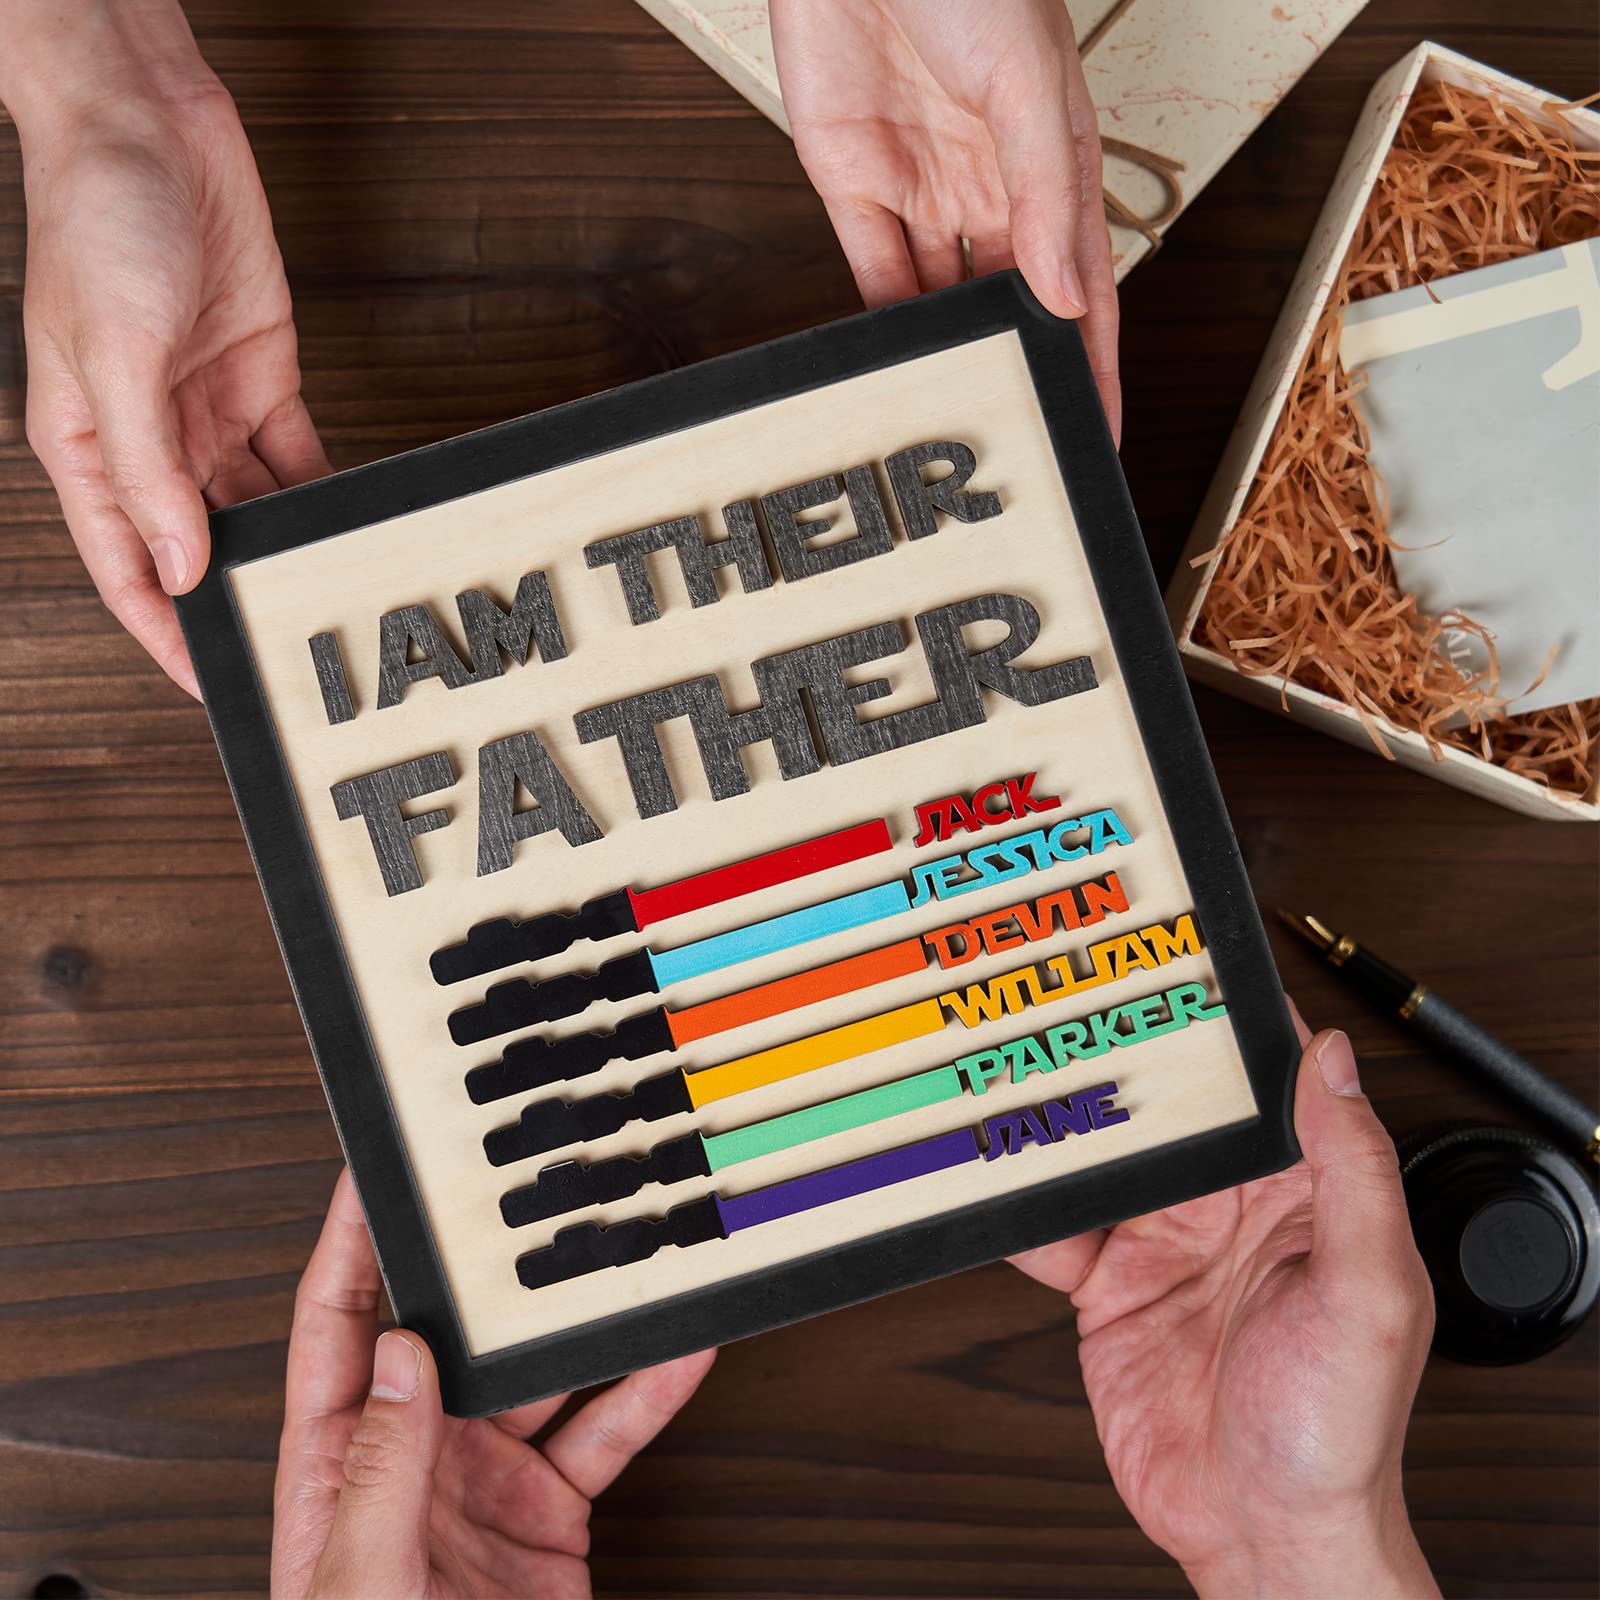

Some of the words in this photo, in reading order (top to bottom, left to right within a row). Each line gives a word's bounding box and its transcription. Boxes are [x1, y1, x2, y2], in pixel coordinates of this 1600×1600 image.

[308, 631, 357, 726] I
[377, 570, 569, 711] AM
[583, 440, 1003, 626] THEIR
[329, 593, 1099, 897] FATHER
[909, 807, 1135, 908] JESSICA
[914, 772, 1062, 848] JACK
[923, 870, 1130, 970] DEVIN
[939, 914, 1202, 1029] WILLIAM
[954, 982, 1227, 1096] PARKER
[981, 1080, 1131, 1162] JANE
